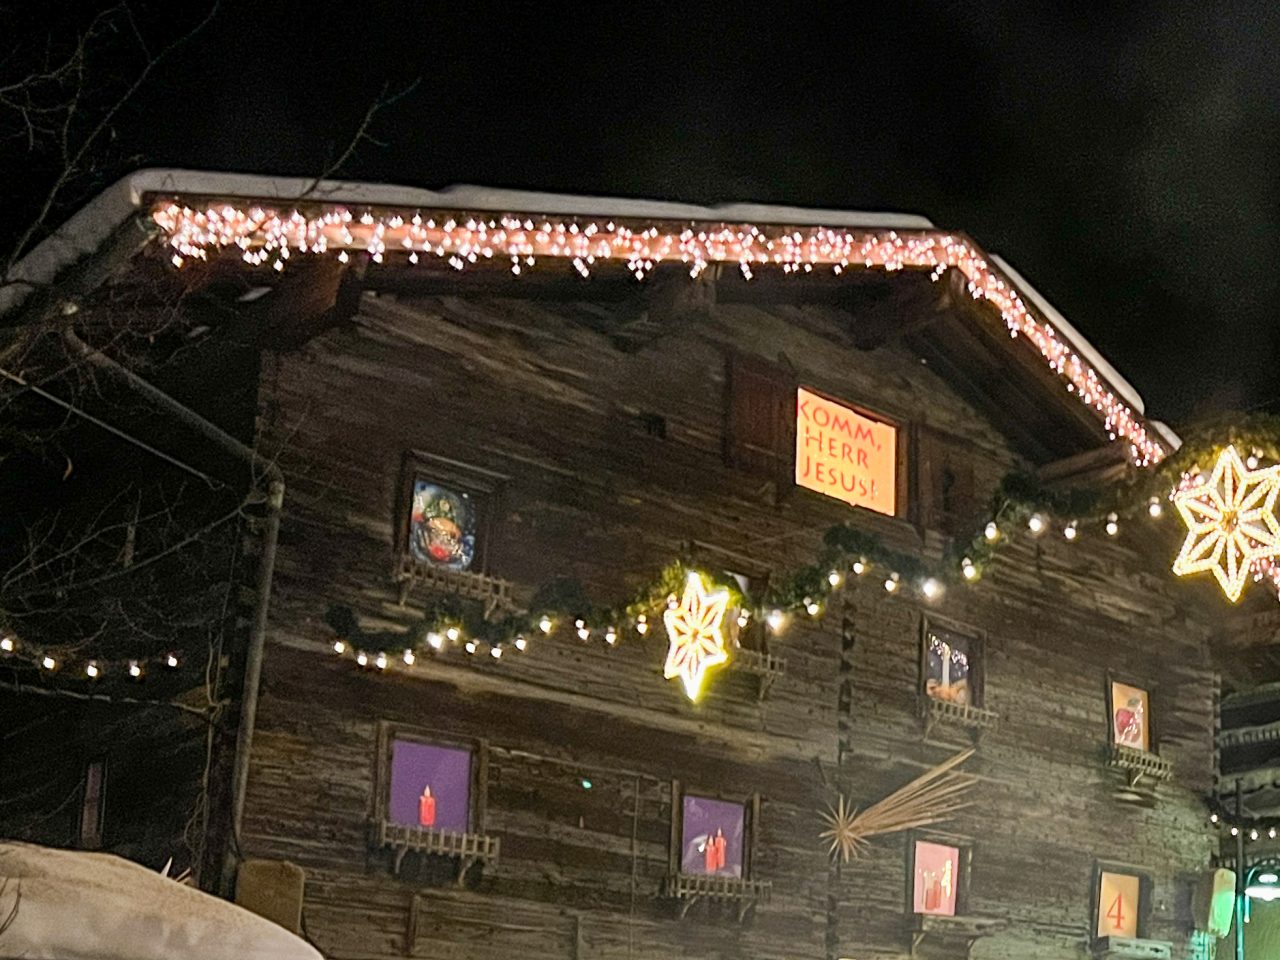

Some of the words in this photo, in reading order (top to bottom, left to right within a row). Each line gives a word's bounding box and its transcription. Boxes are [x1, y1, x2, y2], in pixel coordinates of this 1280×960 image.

[806, 426, 868, 469] HERR
[804, 456, 874, 500] JESUS!
[1107, 893, 1125, 930] 4
